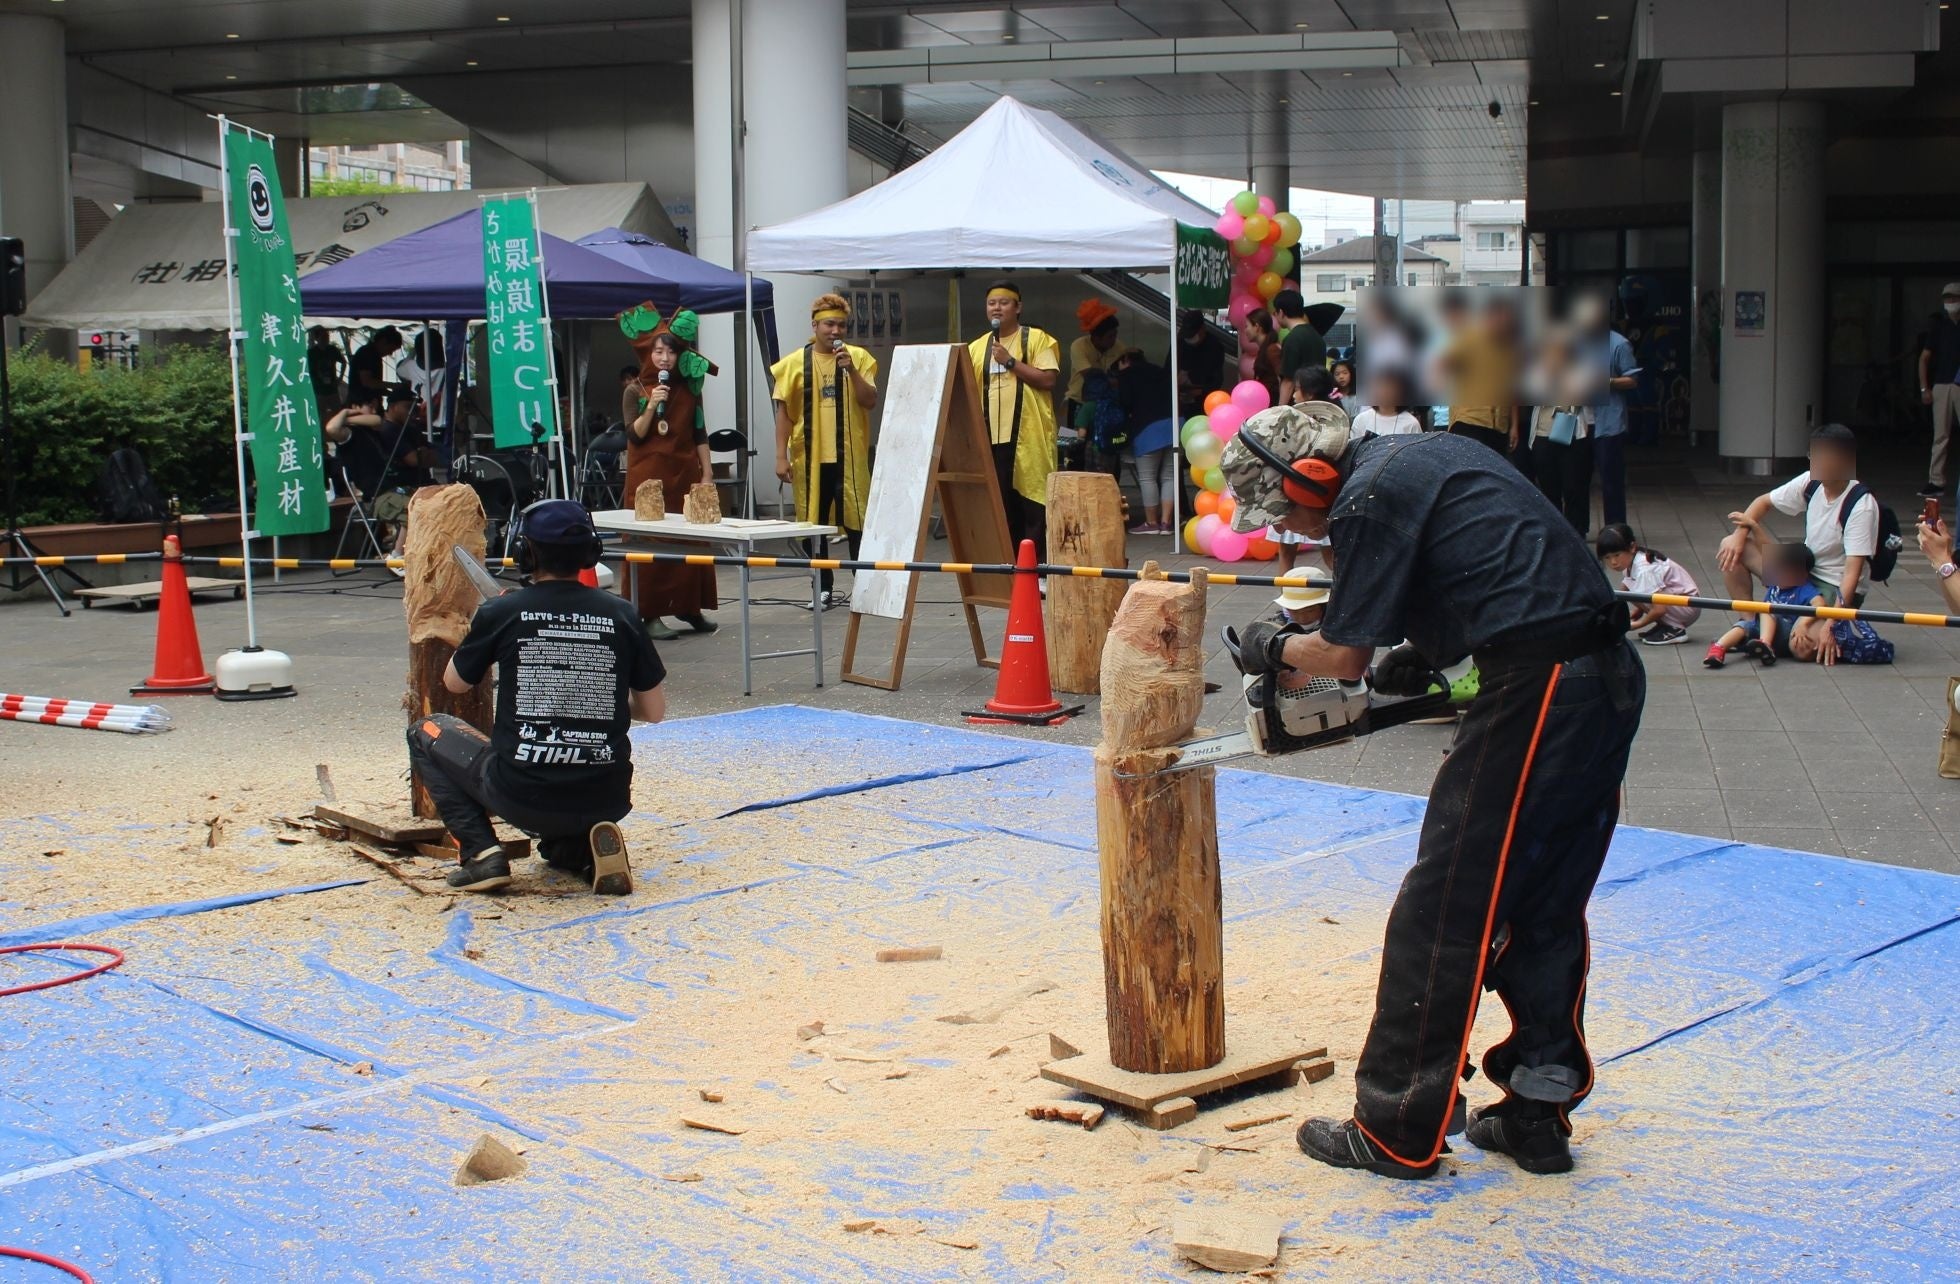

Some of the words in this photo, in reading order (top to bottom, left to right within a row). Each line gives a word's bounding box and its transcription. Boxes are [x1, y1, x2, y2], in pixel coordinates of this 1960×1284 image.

[260, 311, 305, 516] 津久井産材
[520, 611, 614, 626] Carve-a-Palooza
[580, 624, 615, 633] ICHIHARA
[562, 730, 590, 739] CAPTAIN
[590, 731, 608, 740] STAG
[514, 743, 587, 764] STIHL
[1191, 745, 1223, 757] STIHL
